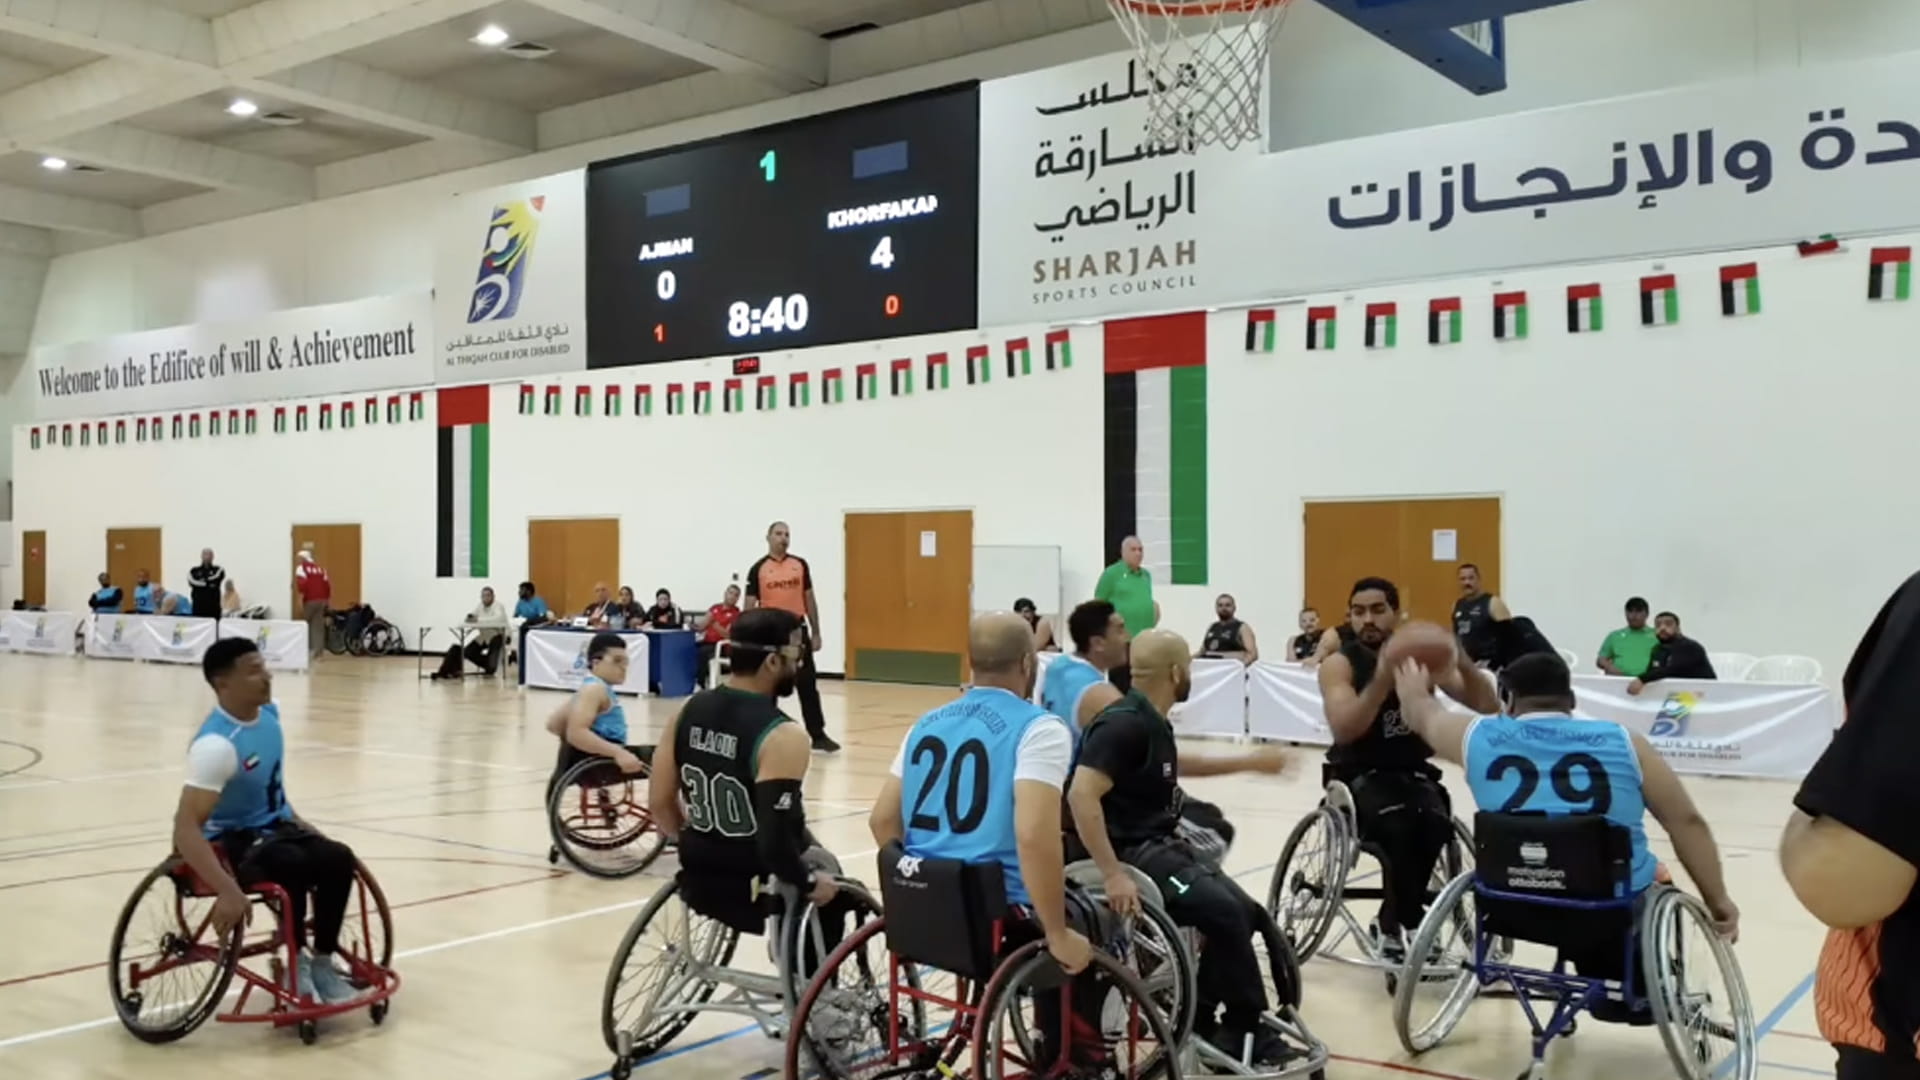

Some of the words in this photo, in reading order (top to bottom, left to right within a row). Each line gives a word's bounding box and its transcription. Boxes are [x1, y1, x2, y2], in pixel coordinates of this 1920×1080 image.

[759, 150, 776, 181] 1
[1328, 128, 1772, 232] والإنجازات
[1034, 170, 1195, 242] الرياضي
[639, 237, 693, 260] AJMAN
[870, 236, 894, 269] 4
[1033, 240, 1196, 283] SHARJAH
[657, 271, 676, 300] 0
[1033, 287, 1097, 304] SPORTS
[1110, 275, 1197, 295] COUNCIL
[728, 294, 808, 337] 8:40
[885, 295, 899, 315] 0
[530, 343, 570, 357] DISABLED
[654, 324, 665, 342] 1
[39, 366, 101, 398] Welcome
[104, 363, 119, 390] to
[122, 356, 146, 388] the
[150, 349, 205, 385] Edifice
[209, 343, 226, 378] of
[231, 339, 261, 374] will
[267, 335, 282, 371] &
[289, 321, 415, 368] Achievement
[681, 764, 758, 837] 30
[909, 735, 990, 834] 20
[1486, 752, 1612, 815] 29
